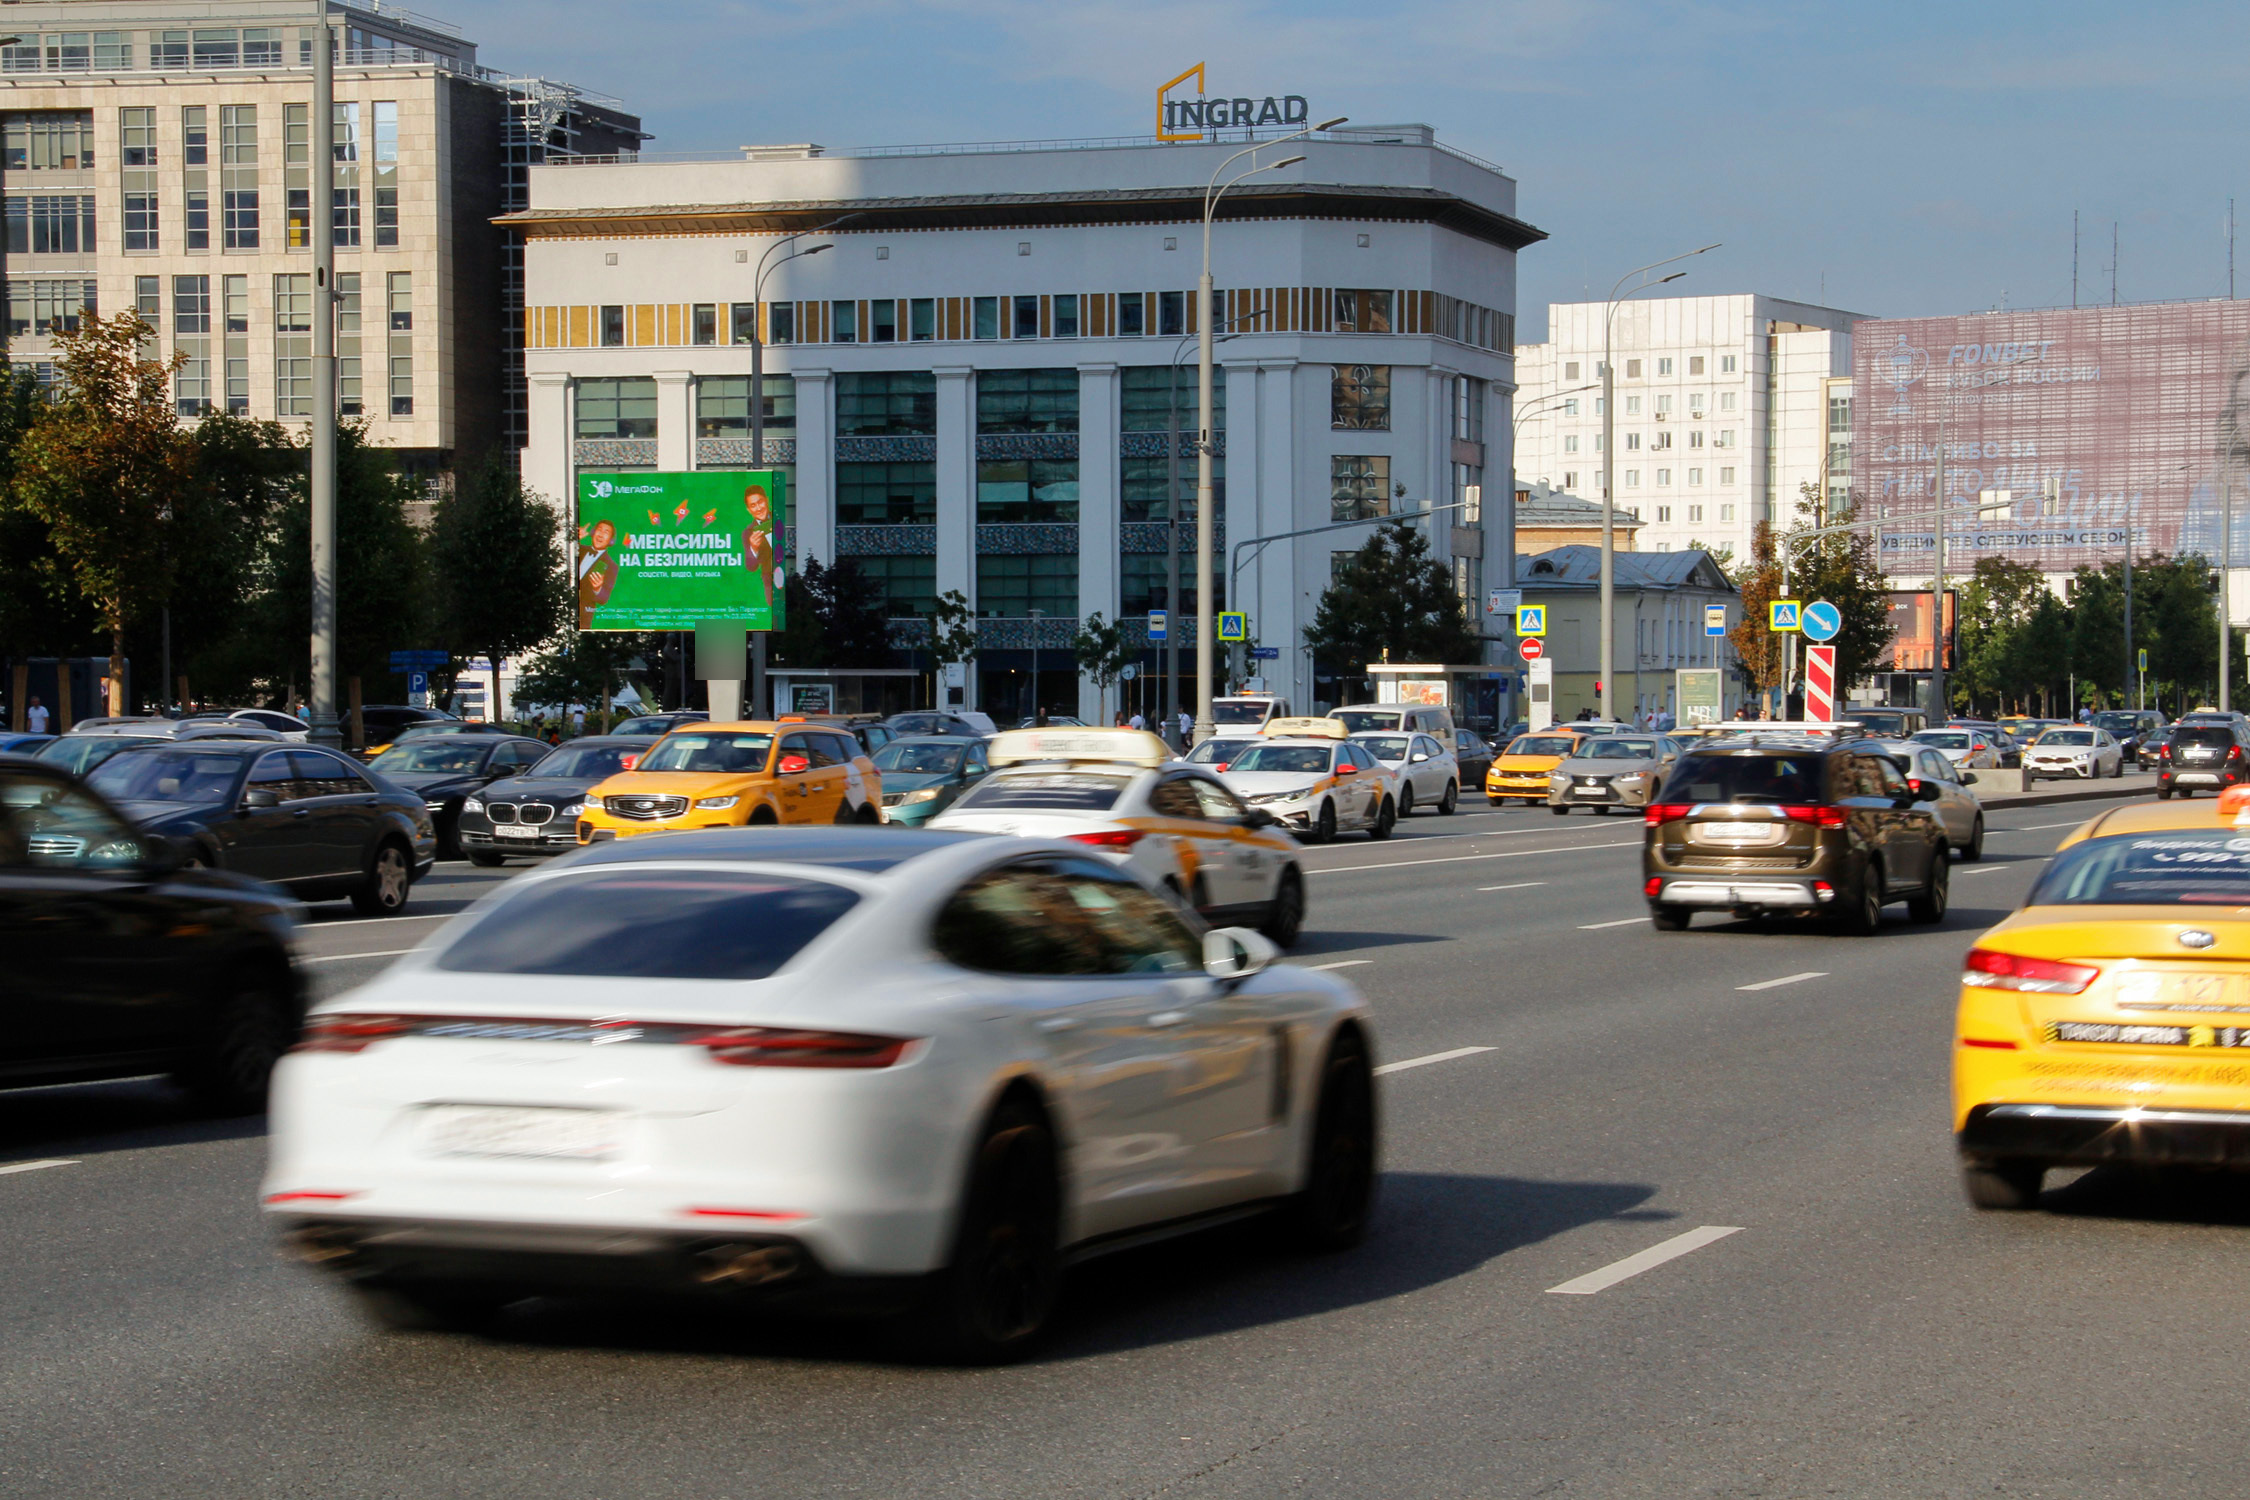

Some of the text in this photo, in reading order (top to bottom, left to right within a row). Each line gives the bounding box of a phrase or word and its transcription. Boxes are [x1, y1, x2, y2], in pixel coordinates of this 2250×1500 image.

[1168, 95, 1308, 128] INGRAD
[1947, 340, 2054, 364] FONBET
[1946, 367, 2101, 388] КУБОК РОССИИ
[1883, 440, 2038, 462] СПАСИБО ЗА
[1950, 490, 2143, 530] ЭОЦИИ
[629, 533, 731, 549] МЕГАСИЛЫ
[1977, 533, 2075, 547] СЛЕДУЮЩЕМ
[619, 553, 742, 567] НА БЕЗЛИМИТЫ
[413, 674, 424, 691] P
